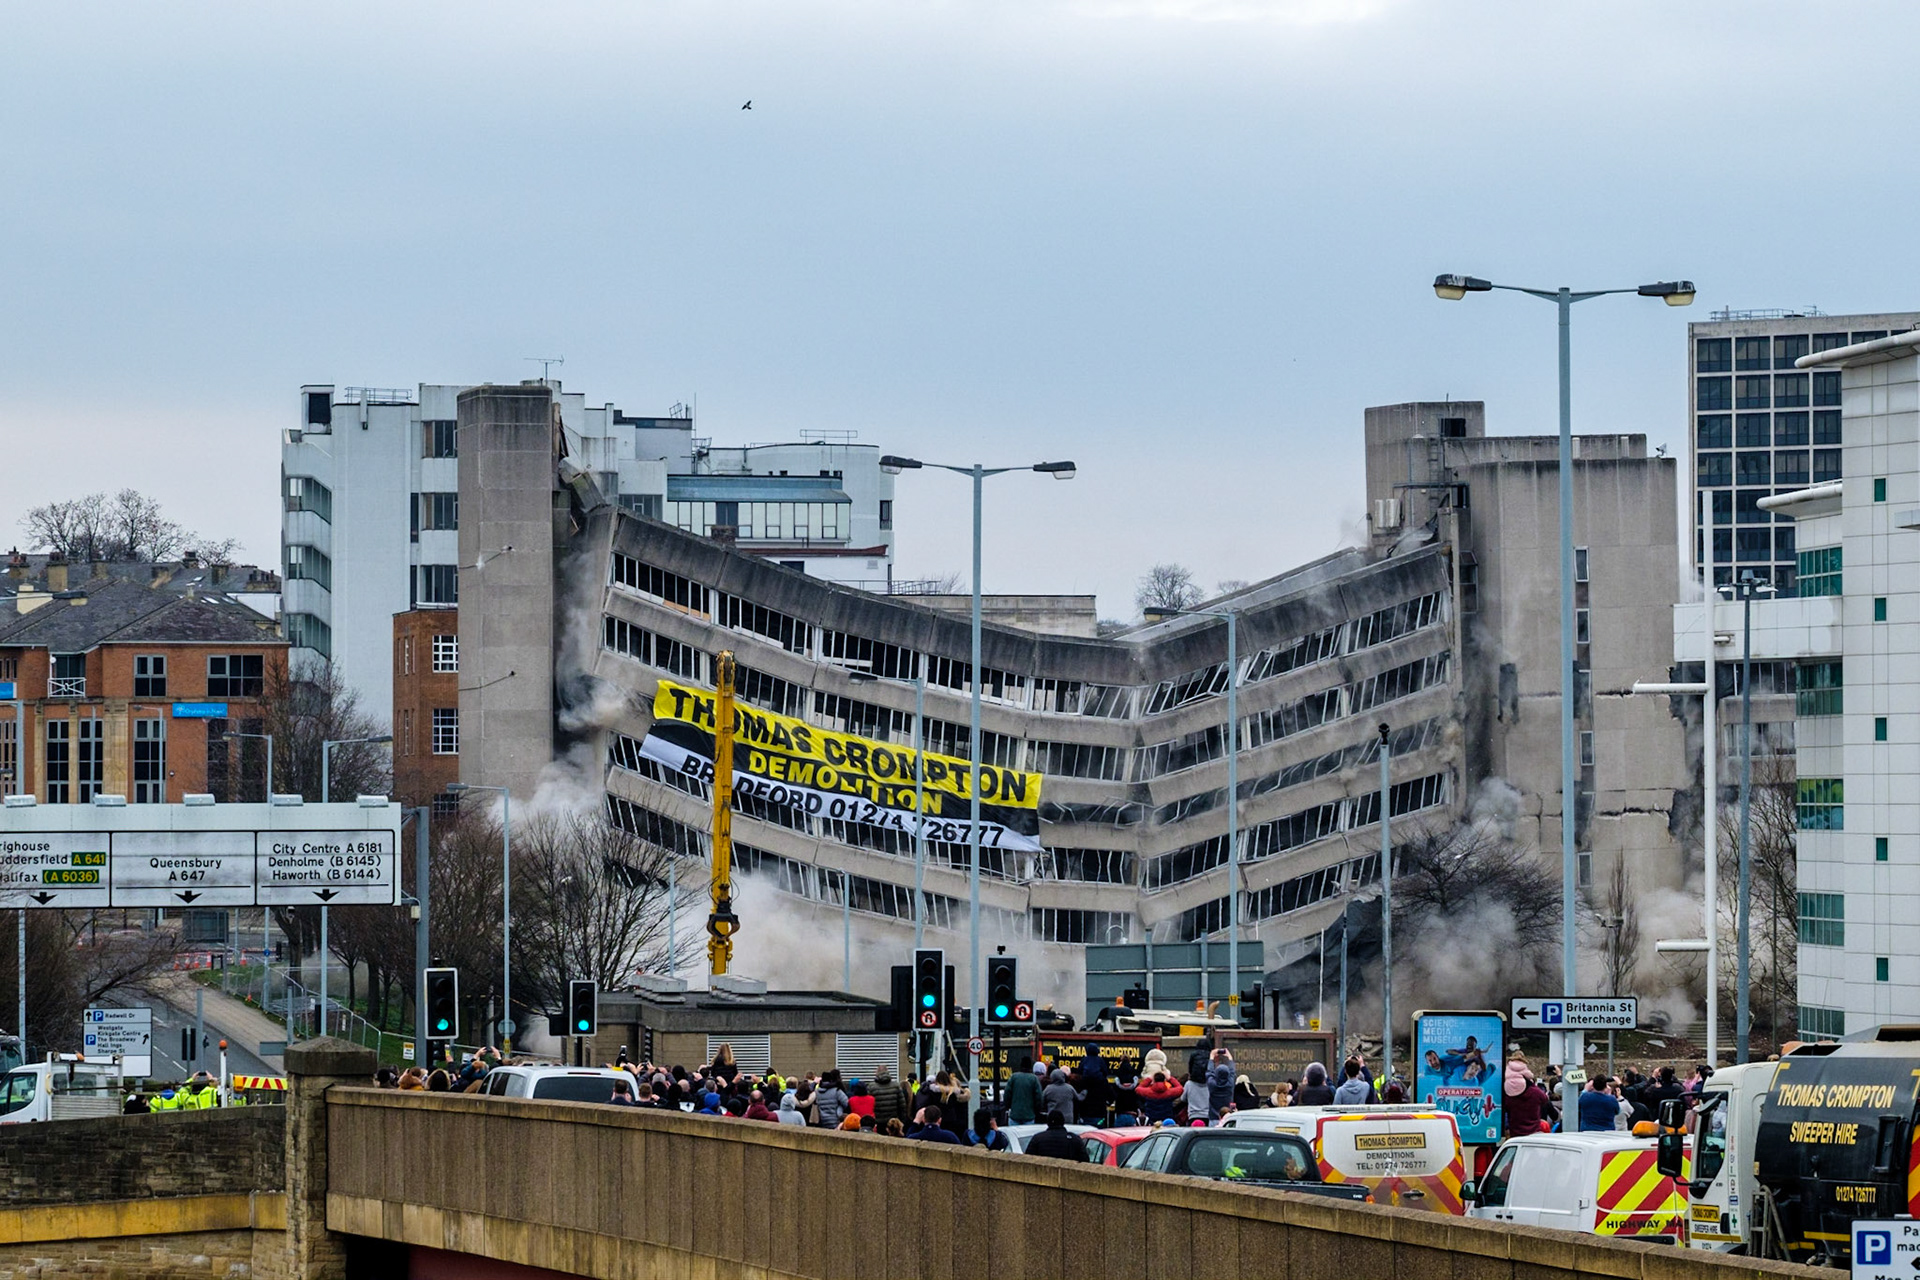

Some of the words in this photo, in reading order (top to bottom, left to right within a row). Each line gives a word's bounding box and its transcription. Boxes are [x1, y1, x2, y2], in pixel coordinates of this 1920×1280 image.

[824, 738, 1026, 802] CROMPTON
[681, 754, 822, 814] BRDFORD
[749, 751, 942, 814] DEMOLITION
[272, 843, 297, 855] City
[302, 843, 341, 853] Centre
[346, 843, 354, 853] A
[357, 843, 382, 853] 6181
[73, 854, 81, 865] A
[85, 854, 105, 865] 641
[150, 858, 222, 869] Queensbury
[268, 857, 325, 867] Denholme
[330, 856, 343, 867] (B
[346, 855, 382, 866] 6145)
[44, 870, 58, 883] (A
[62, 870, 98, 883] 6036)
[168, 871, 177, 881] A
[181, 871, 205, 881] 647
[272, 870, 321, 880] Haworth
[327, 869, 340, 881] (B
[344, 868, 381, 880] 6144)
[1566, 1002, 1616, 1012] Britannia
[1619, 1002, 1632, 1012] St
[1566, 1014, 1632, 1025] Interchange
[1423, 1036, 1462, 1044] MUSEUM
[1058, 1046, 1087, 1057] THOMA
[1233, 1049, 1266, 1060] THOMAS
[1268, 1049, 1313, 1061] CROMPTON
[1235, 1062, 1279, 1071] BRADFORD
[1777, 1084, 1827, 1108] THOMAS
[1826, 1085, 1896, 1108] CROMPTON
[1789, 1121, 1835, 1144] SWEEPER
[1834, 1123, 1859, 1145] HIRE
[1359, 1137, 1386, 1147] THOMAS
[1387, 1136, 1422, 1147] CROMPTON
[1366, 1151, 1415, 1159] DEMOLITIONS
[1356, 1162, 1373, 1170] TEL:
[1400, 1161, 1427, 1169] 726777
[1836, 1186, 1854, 1202] 01274
[1854, 1186, 1876, 1203] 726777
[1606, 1220, 1660, 1229] HIGHWAY
